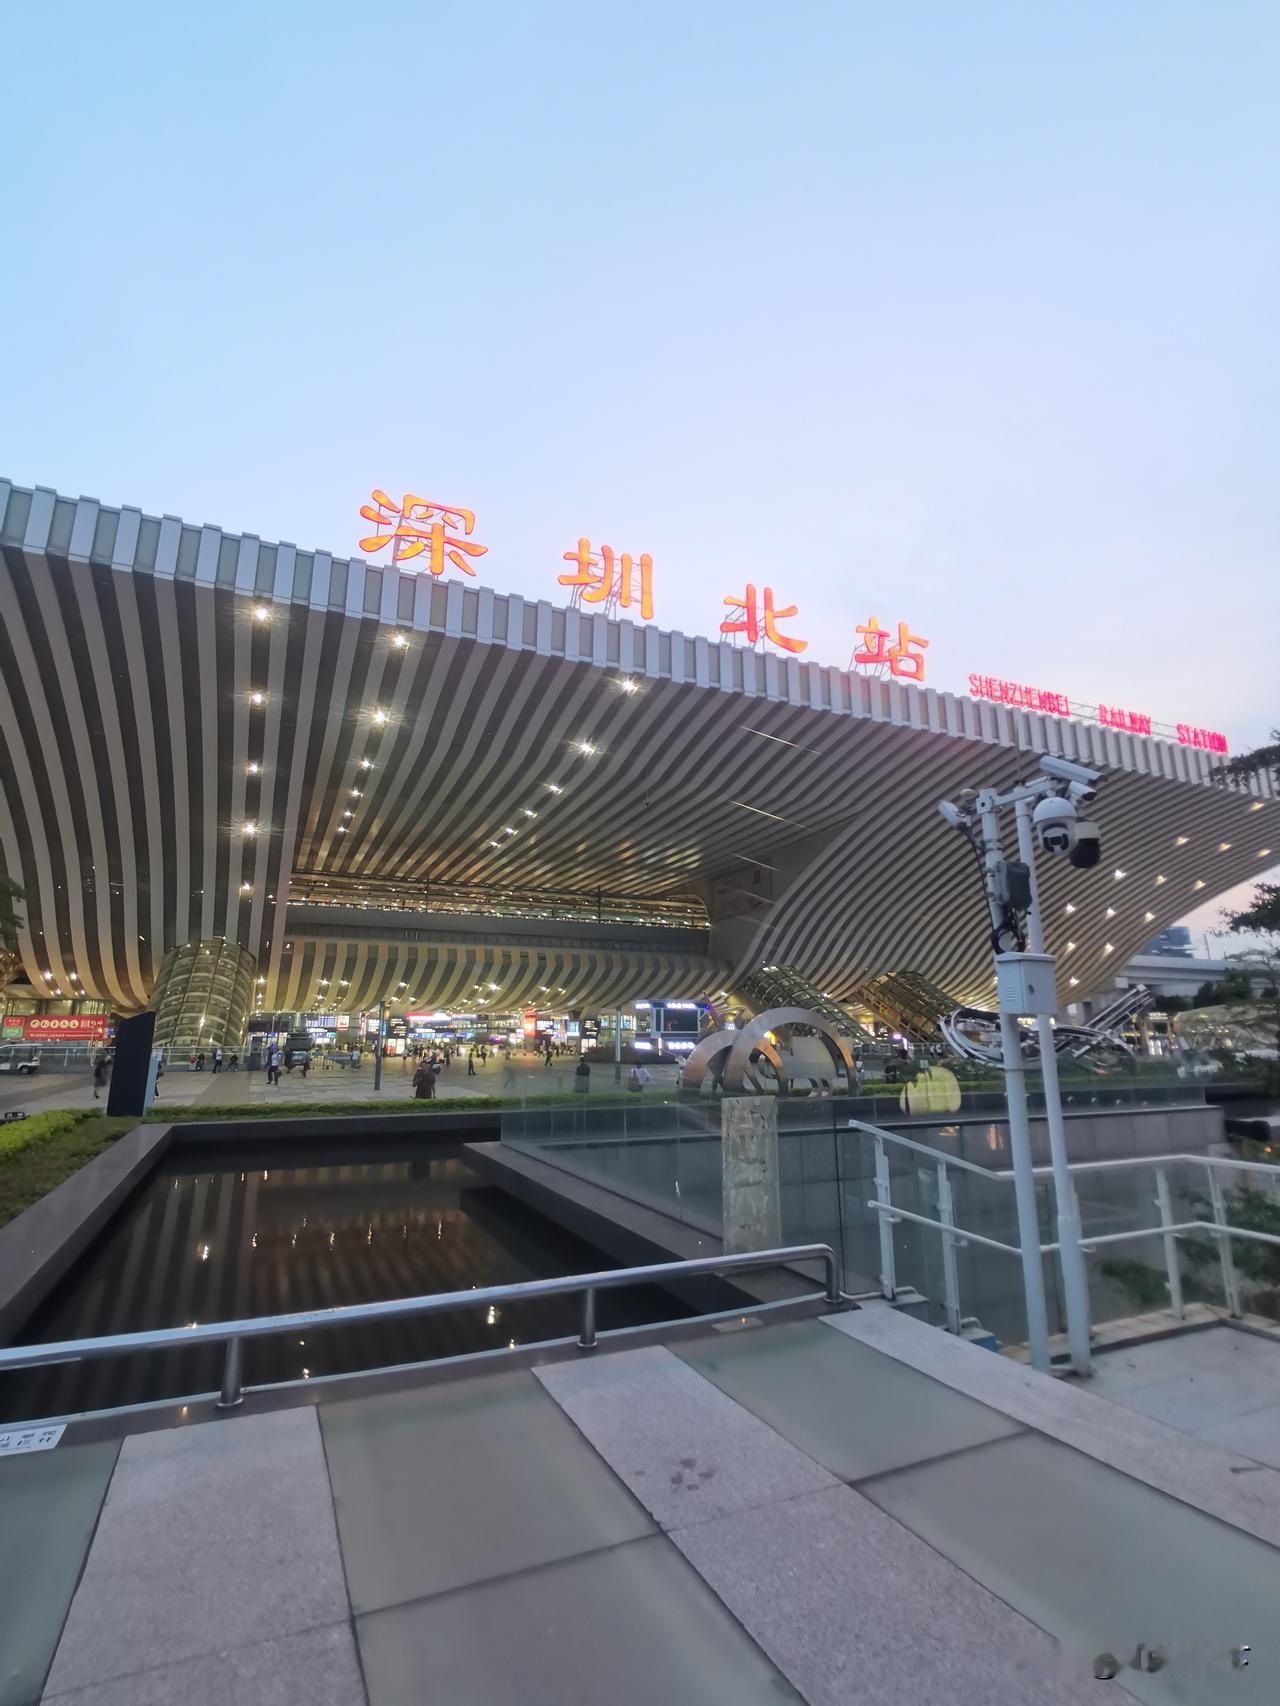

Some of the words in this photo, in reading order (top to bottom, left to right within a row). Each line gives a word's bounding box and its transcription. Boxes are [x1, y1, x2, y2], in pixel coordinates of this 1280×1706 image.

[358, 489, 929, 682] 深圳北站
[968, 673, 1071, 717] SHENZHENBEI
[1098, 704, 1151, 736] RAILWAY
[1175, 723, 1229, 754] STATION
